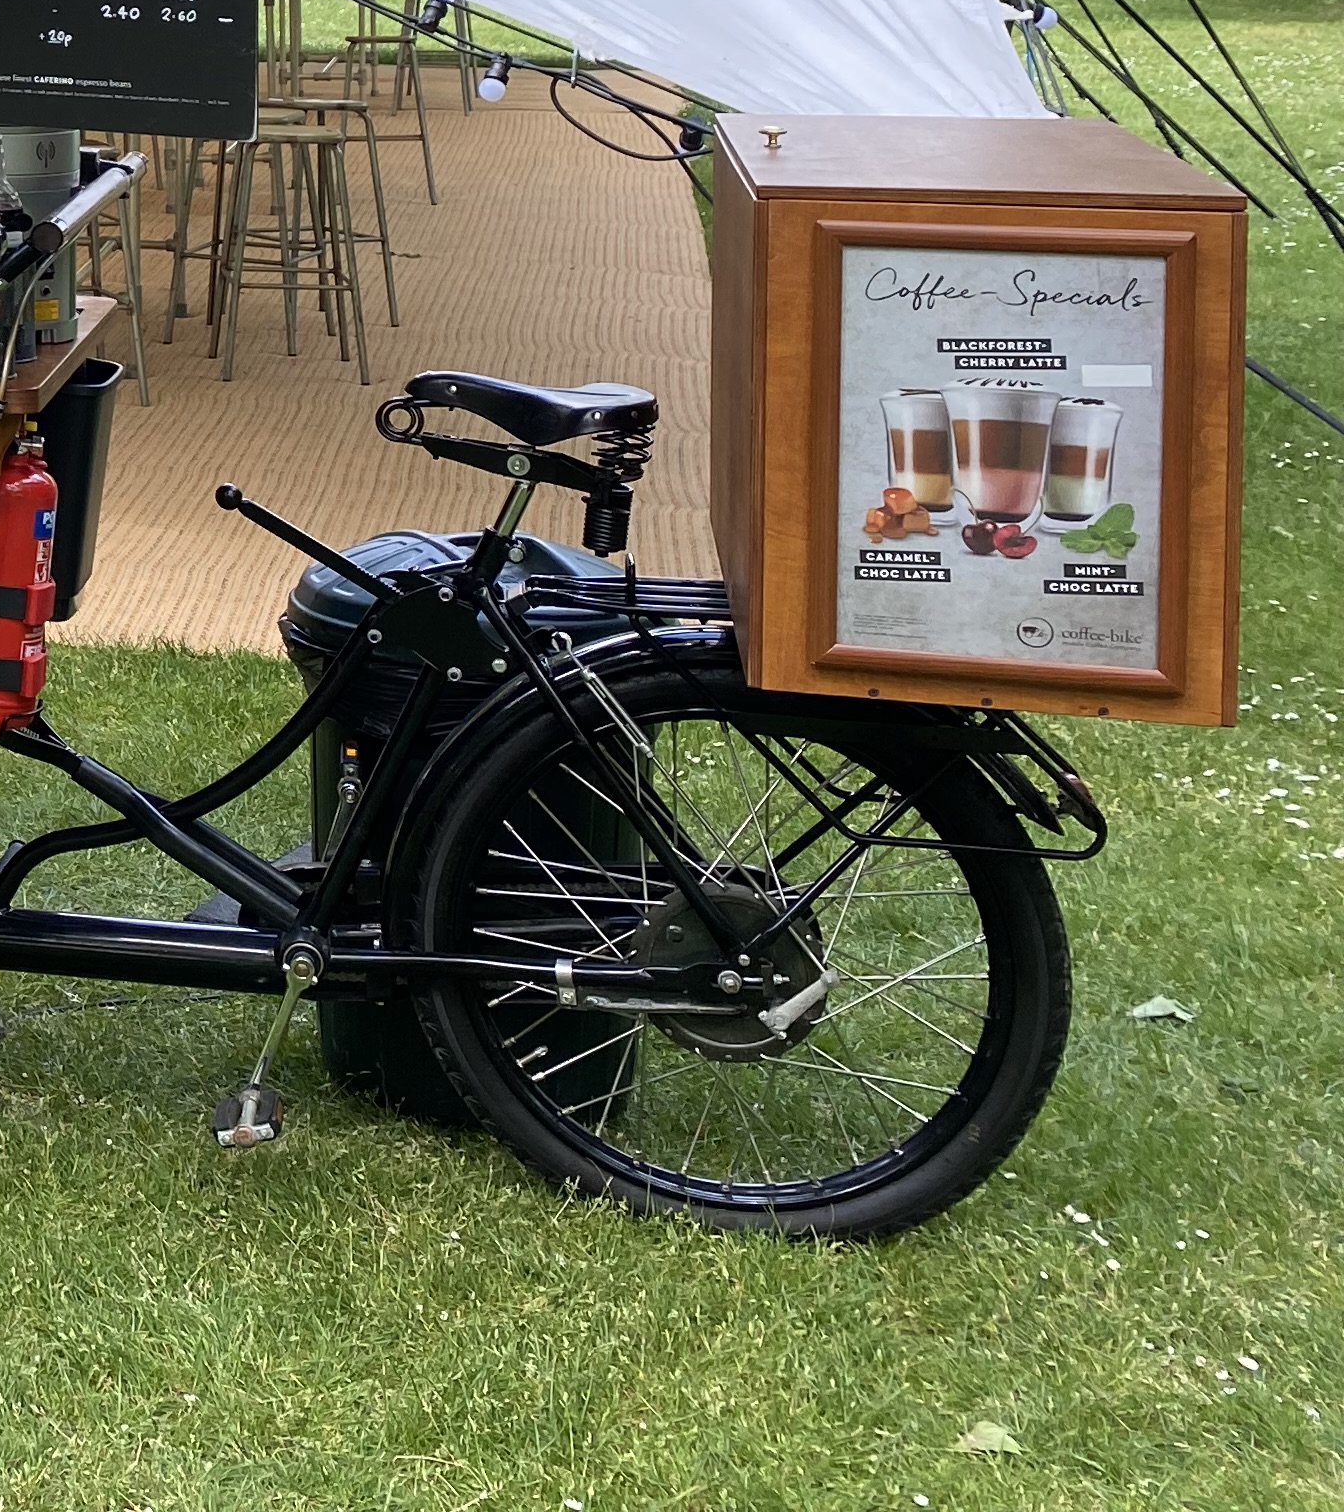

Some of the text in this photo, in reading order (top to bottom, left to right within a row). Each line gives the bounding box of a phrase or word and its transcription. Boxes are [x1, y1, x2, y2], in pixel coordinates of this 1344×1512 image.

[100, 5, 197, 22] 2.40 2.60
[33, 76, 74, 85] CAFERINO
[942, 341, 1047, 351] BLACKFOREST-
[959, 358, 1062, 368] CHERRY LATTE
[865, 552, 936, 563] CARAMEL-
[859, 568, 946, 580] CHOC LATTE
[1074, 566, 1116, 576] MINT-
[1049, 582, 1139, 594] CHOC LATTE
[1061, 627, 1143, 645] coffee-bike
